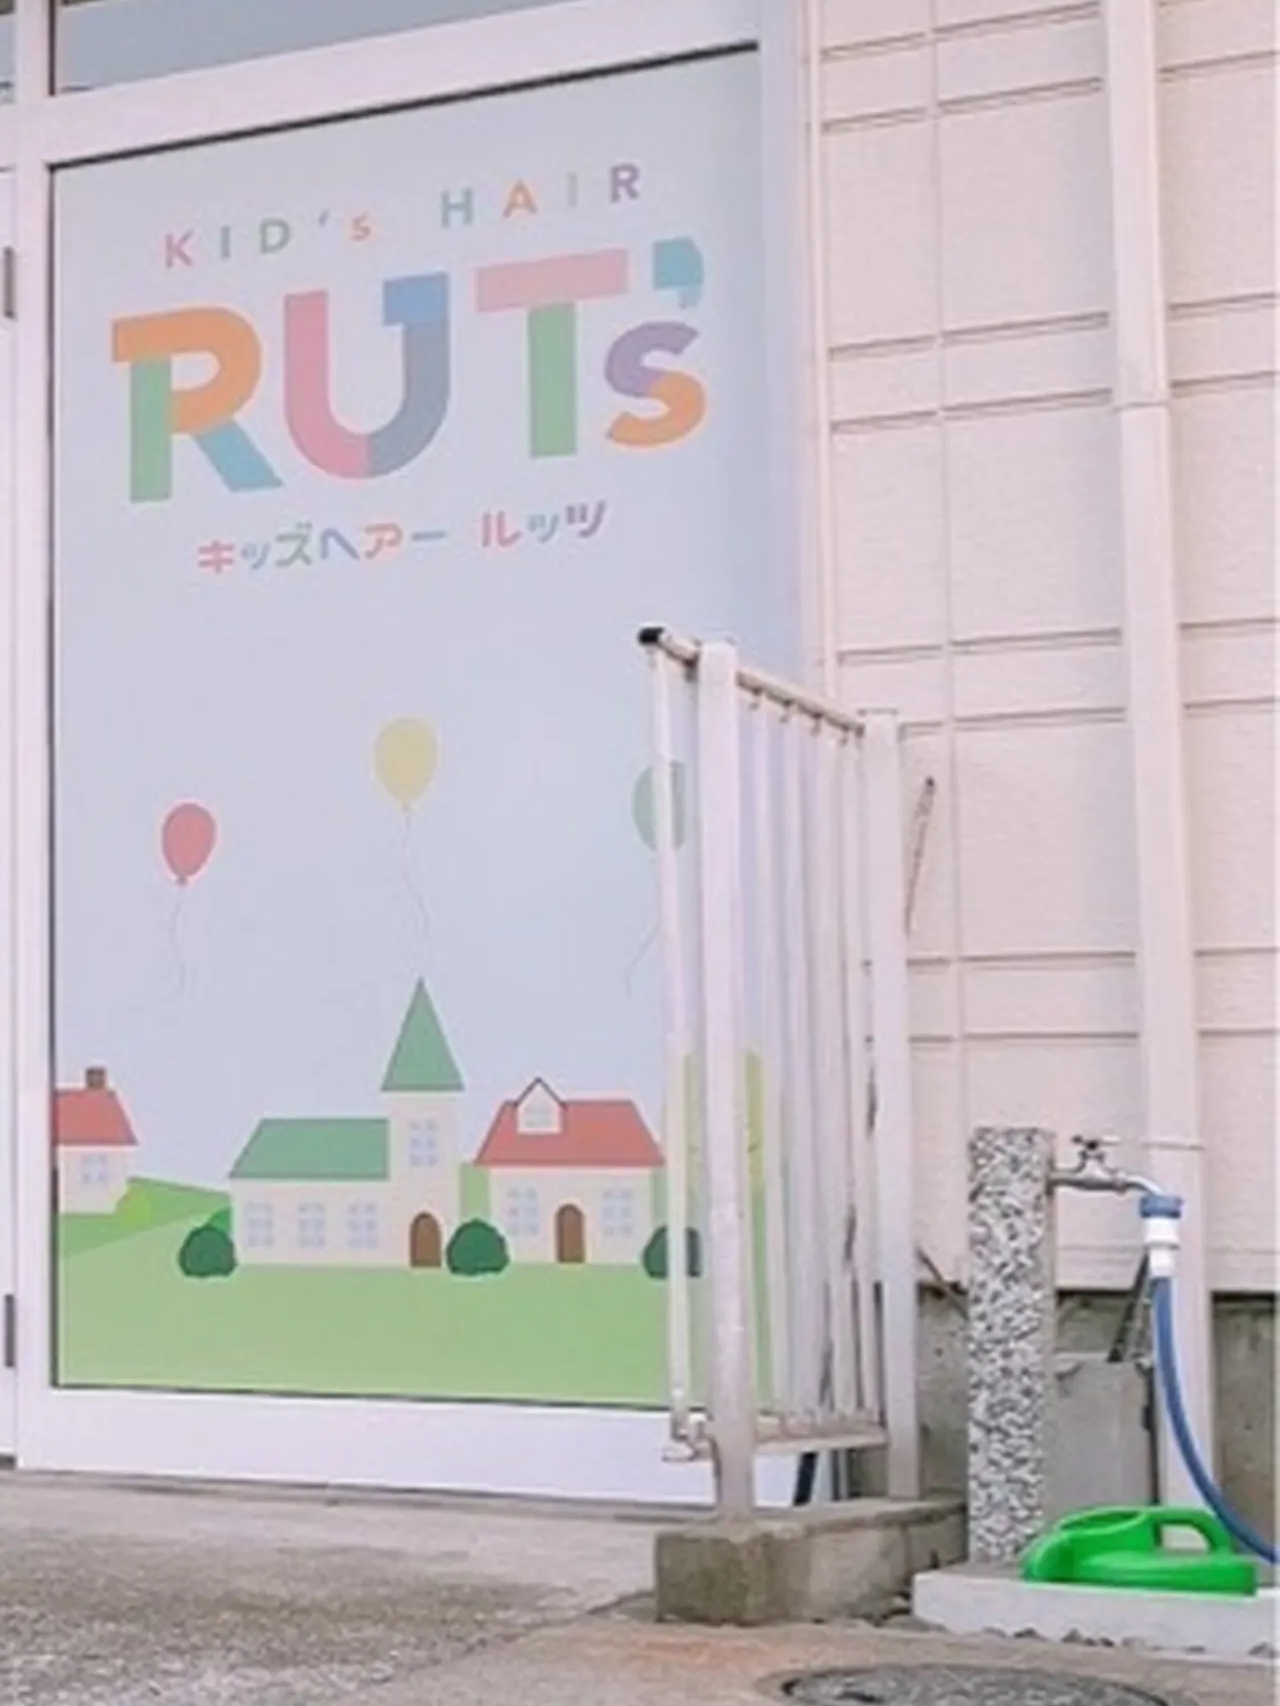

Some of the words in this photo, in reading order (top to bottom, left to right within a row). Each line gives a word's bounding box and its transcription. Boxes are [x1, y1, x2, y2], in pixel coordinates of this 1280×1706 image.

[163, 208, 373, 270] KID's
[440, 162, 641, 230] HAIR
[111, 236, 708, 506] RUT's
[197, 521, 449, 576] キッズヘアー
[480, 500, 609, 551] ルッツ
